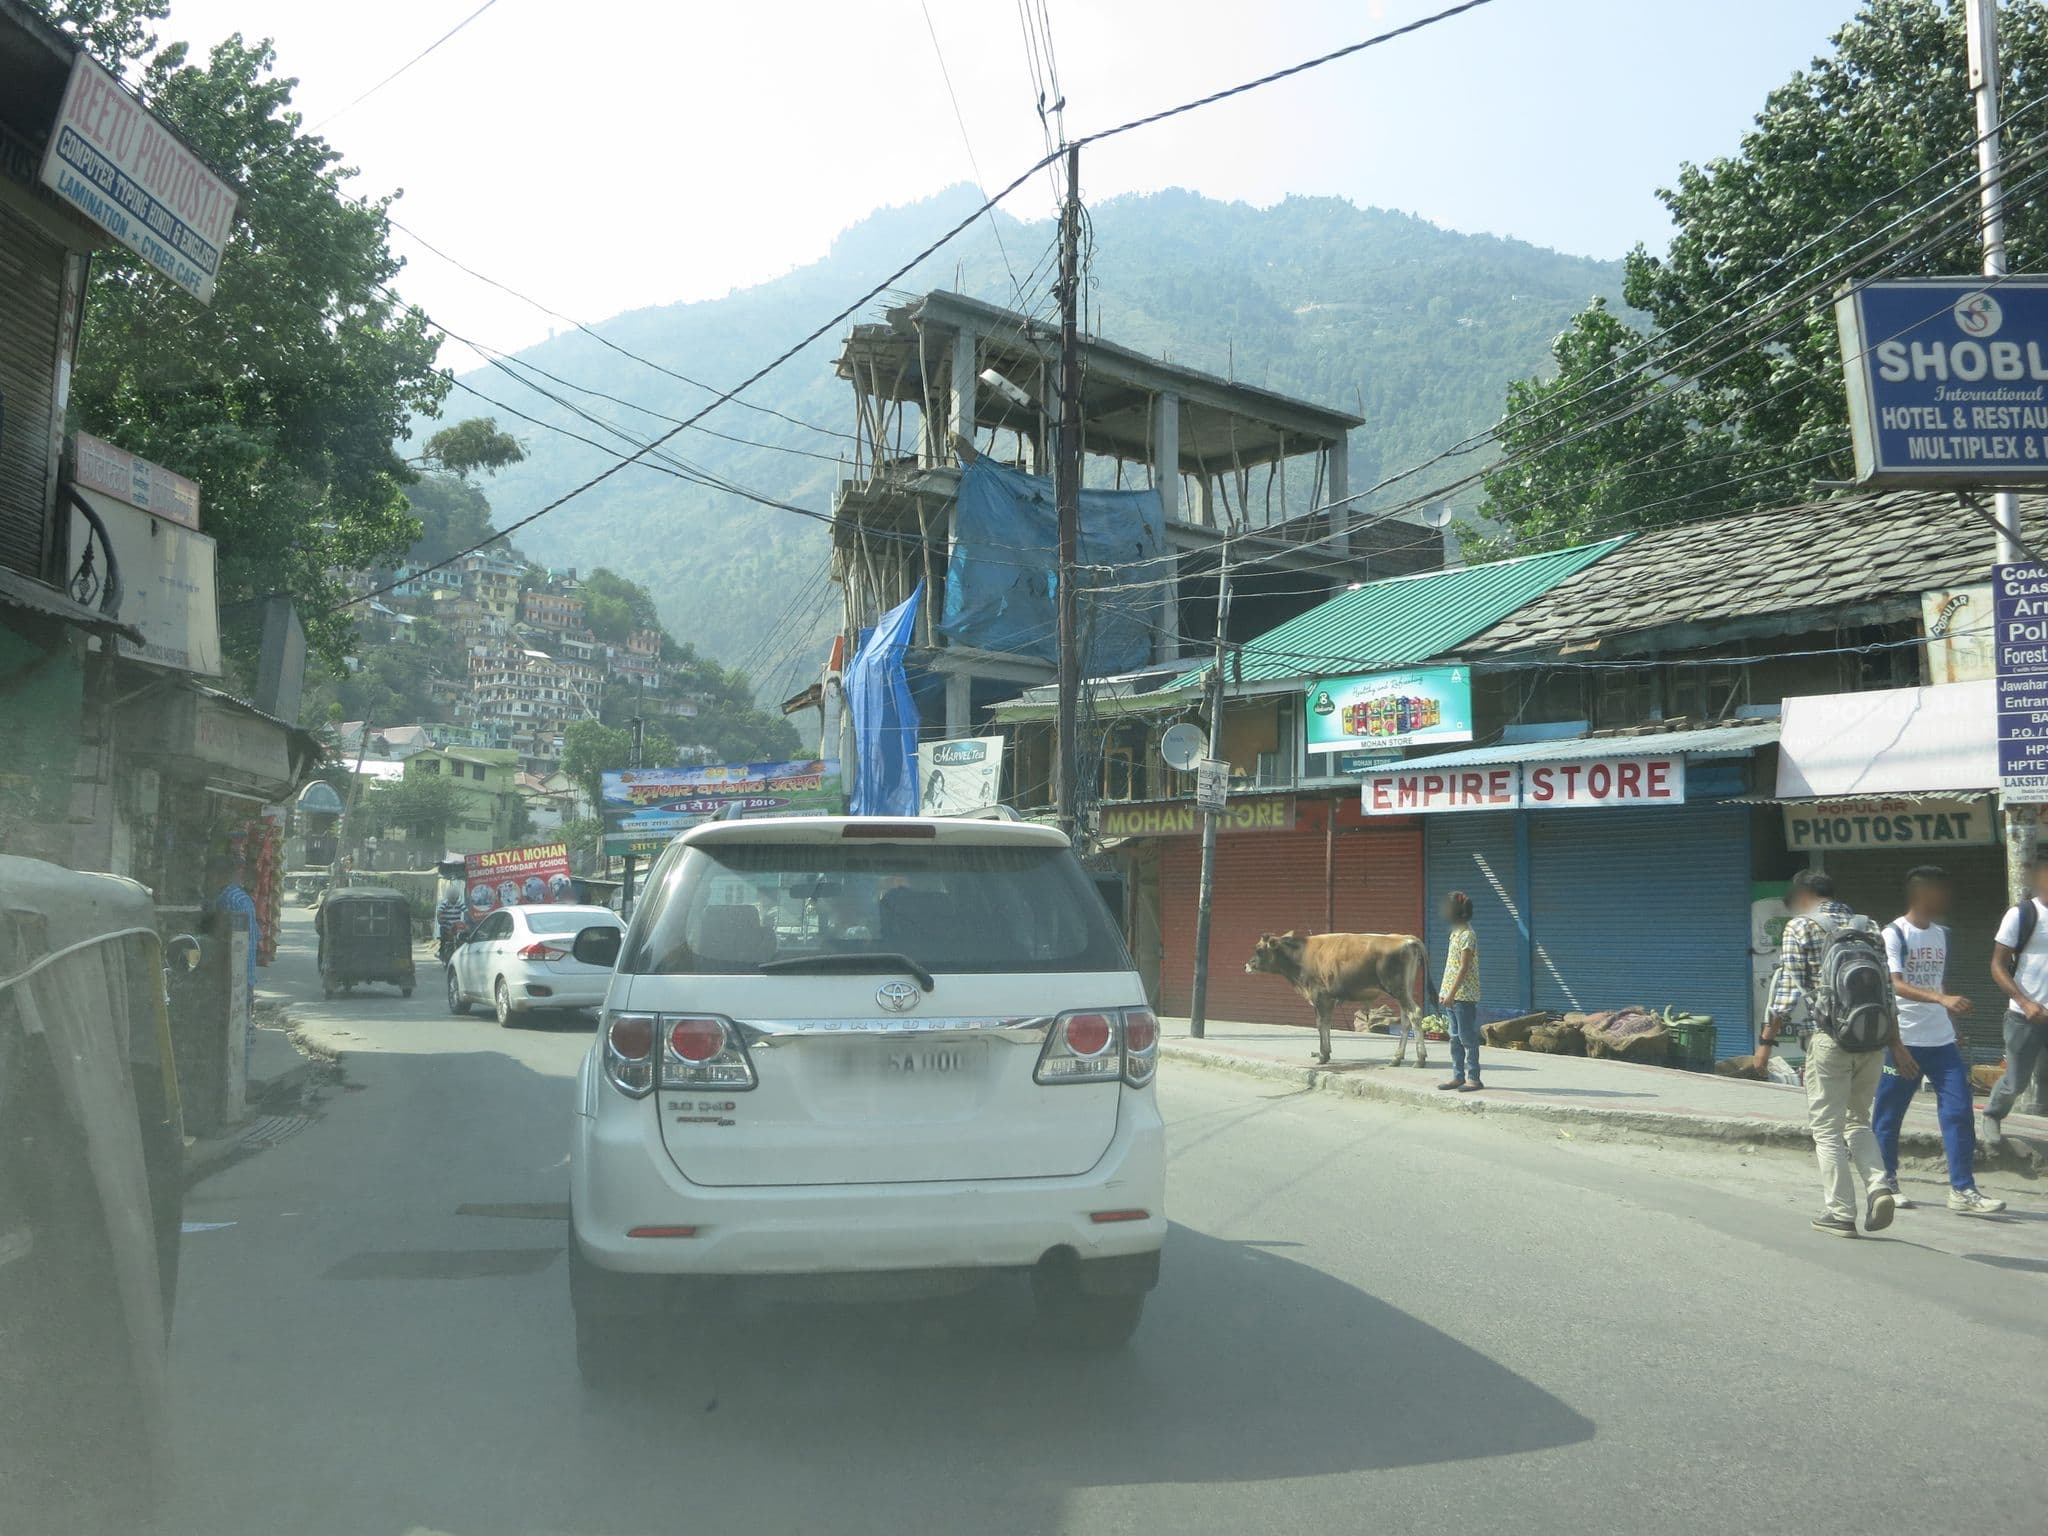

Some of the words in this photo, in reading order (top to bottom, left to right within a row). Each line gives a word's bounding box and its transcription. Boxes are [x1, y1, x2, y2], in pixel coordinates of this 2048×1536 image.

[69, 66, 139, 162] REETU
[132, 124, 233, 243] PHOTOSTAT
[60, 129, 115, 188] COMPUTER
[115, 172, 150, 216] TYPING
[57, 169, 129, 235] LAMINATION
[142, 235, 176, 275] CYBER
[1935, 385, 2044, 402] International
[1882, 407, 1948, 430] HOTEL
[1953, 407, 1967, 429] &
[1908, 436, 2019, 460] MULTIPLEX
[2025, 436, 2038, 459] &
[1933, 595, 1968, 635] POPULAR
[2014, 599, 2048, 617] Ar
[1361, 738, 1388, 748] MOHAN
[1389, 737, 1414, 746] STORE
[2008, 760, 2048, 771] HPTE
[1373, 771, 1511, 809] EMPIRE
[1531, 762, 1671, 801] STORE
[751, 799, 776, 807] 2016
[1107, 807, 1194, 833] MOHAN
[1792, 812, 1970, 845] PHOTOSTAT
[481, 852, 521, 866] SATYA
[524, 843, 566, 860] MOHAN
[496, 862, 538, 873] SECONDARY
[540, 858, 568, 868] SCHOOL
[1910, 947, 1932, 960] LIFE
[1936, 947, 1945, 960] IS
[1906, 960, 1944, 973] SHORT
